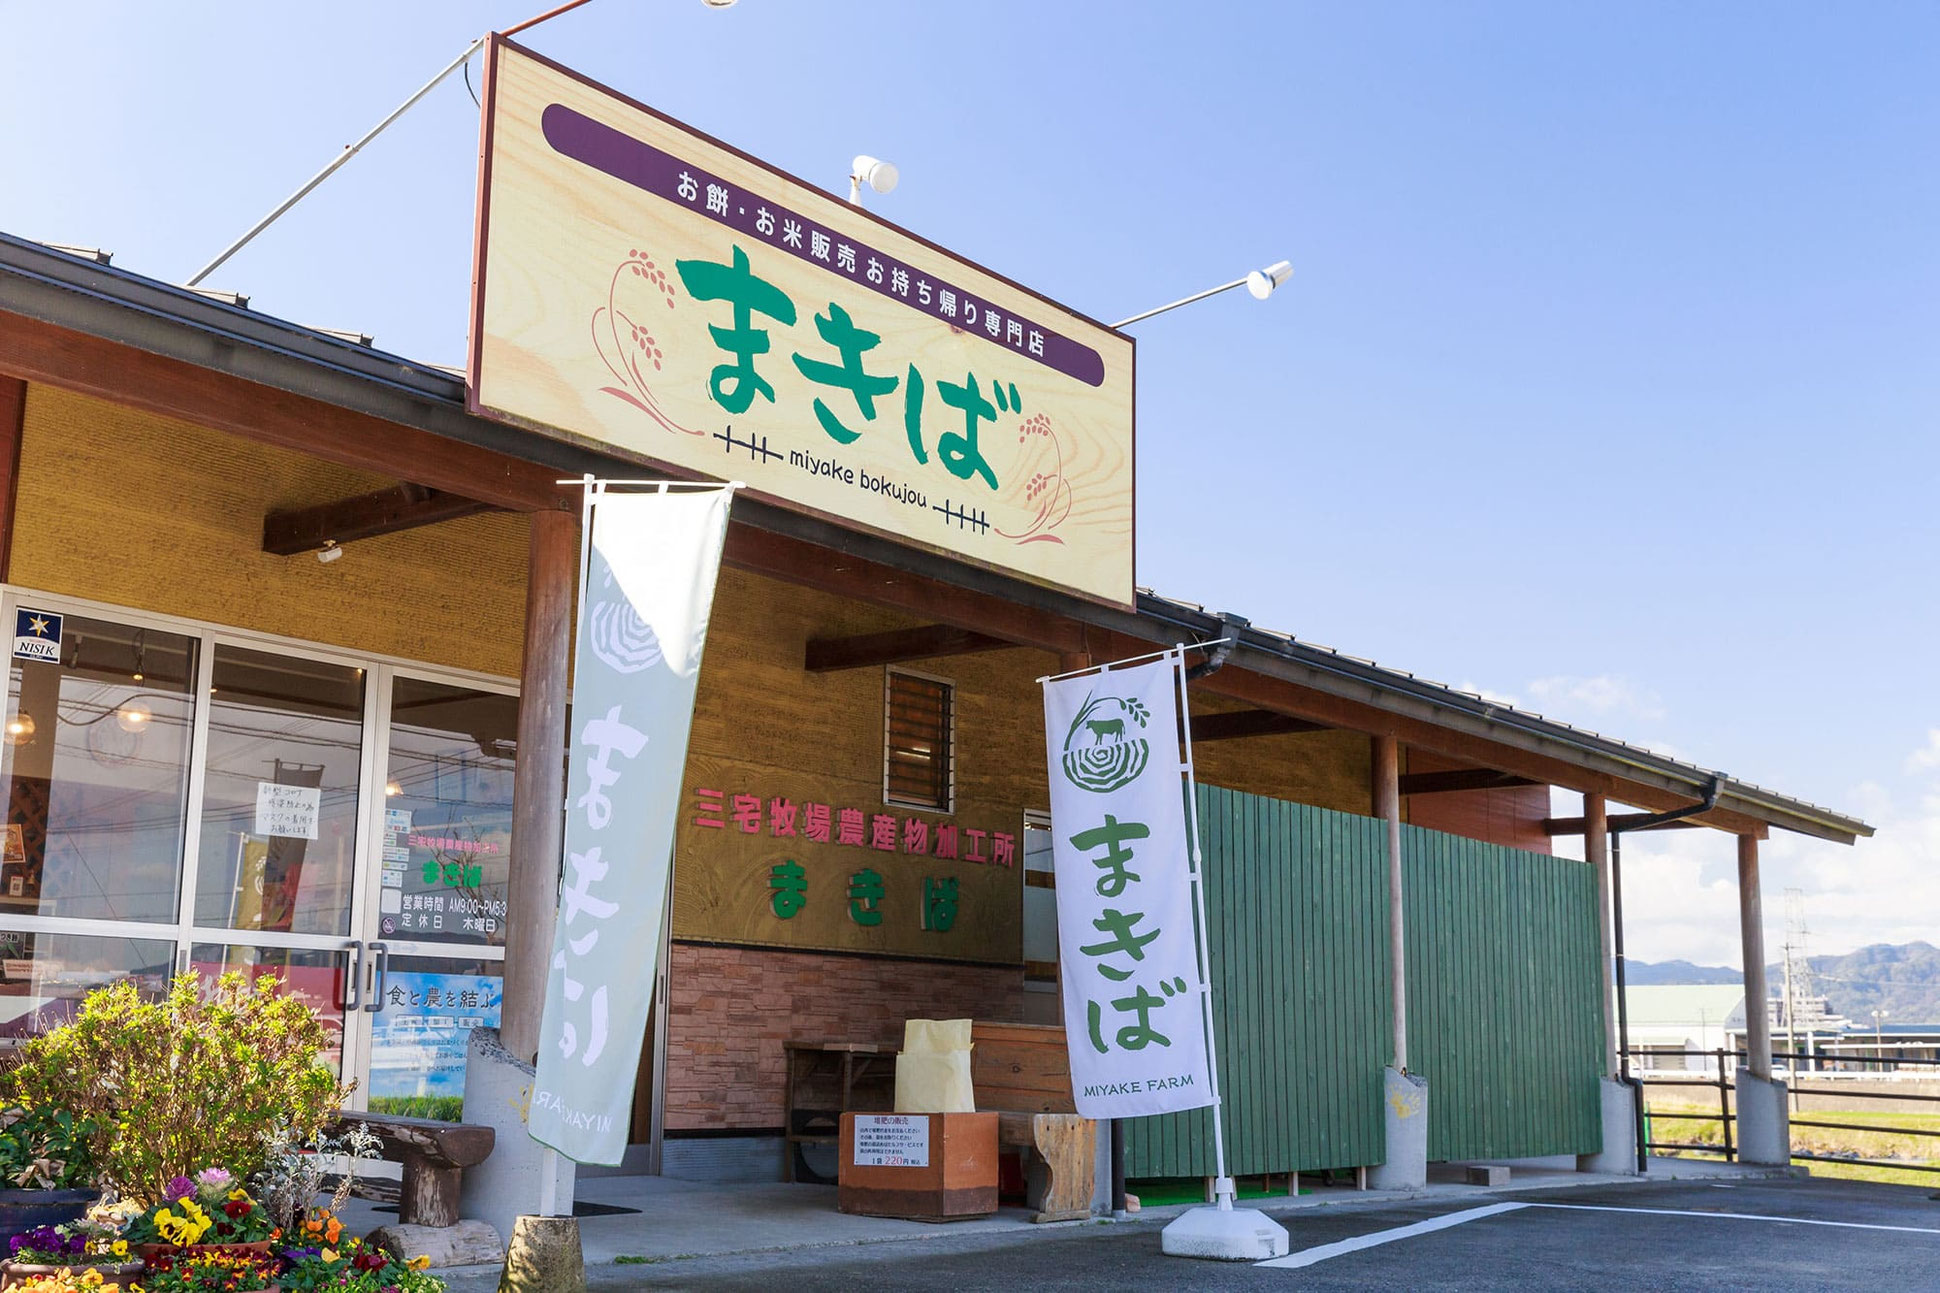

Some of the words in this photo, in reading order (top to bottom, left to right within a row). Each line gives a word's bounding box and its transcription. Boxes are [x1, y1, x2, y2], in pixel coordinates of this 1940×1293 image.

[677, 172, 856, 273] お餅・お米販売
[867, 257, 1044, 357] お持ち帰り専門店
[676, 244, 1021, 491] まきば
[790, 450, 854, 484] miyake
[860, 469, 927, 508] bokujou
[692, 788, 1015, 868] 三宅牧場農産物加工所
[402, 894, 444, 912] 営業時間
[422, 860, 482, 888] まきば
[768, 859, 960, 932] まきば
[463, 917, 496, 932] 木曜日
[1069, 814, 1186, 1054] まきば
[386, 985, 495, 1010] 食と農を結ぶ
[1084, 1081, 1141, 1097] MIYAKE
[1147, 1074, 1194, 1091] FARM
